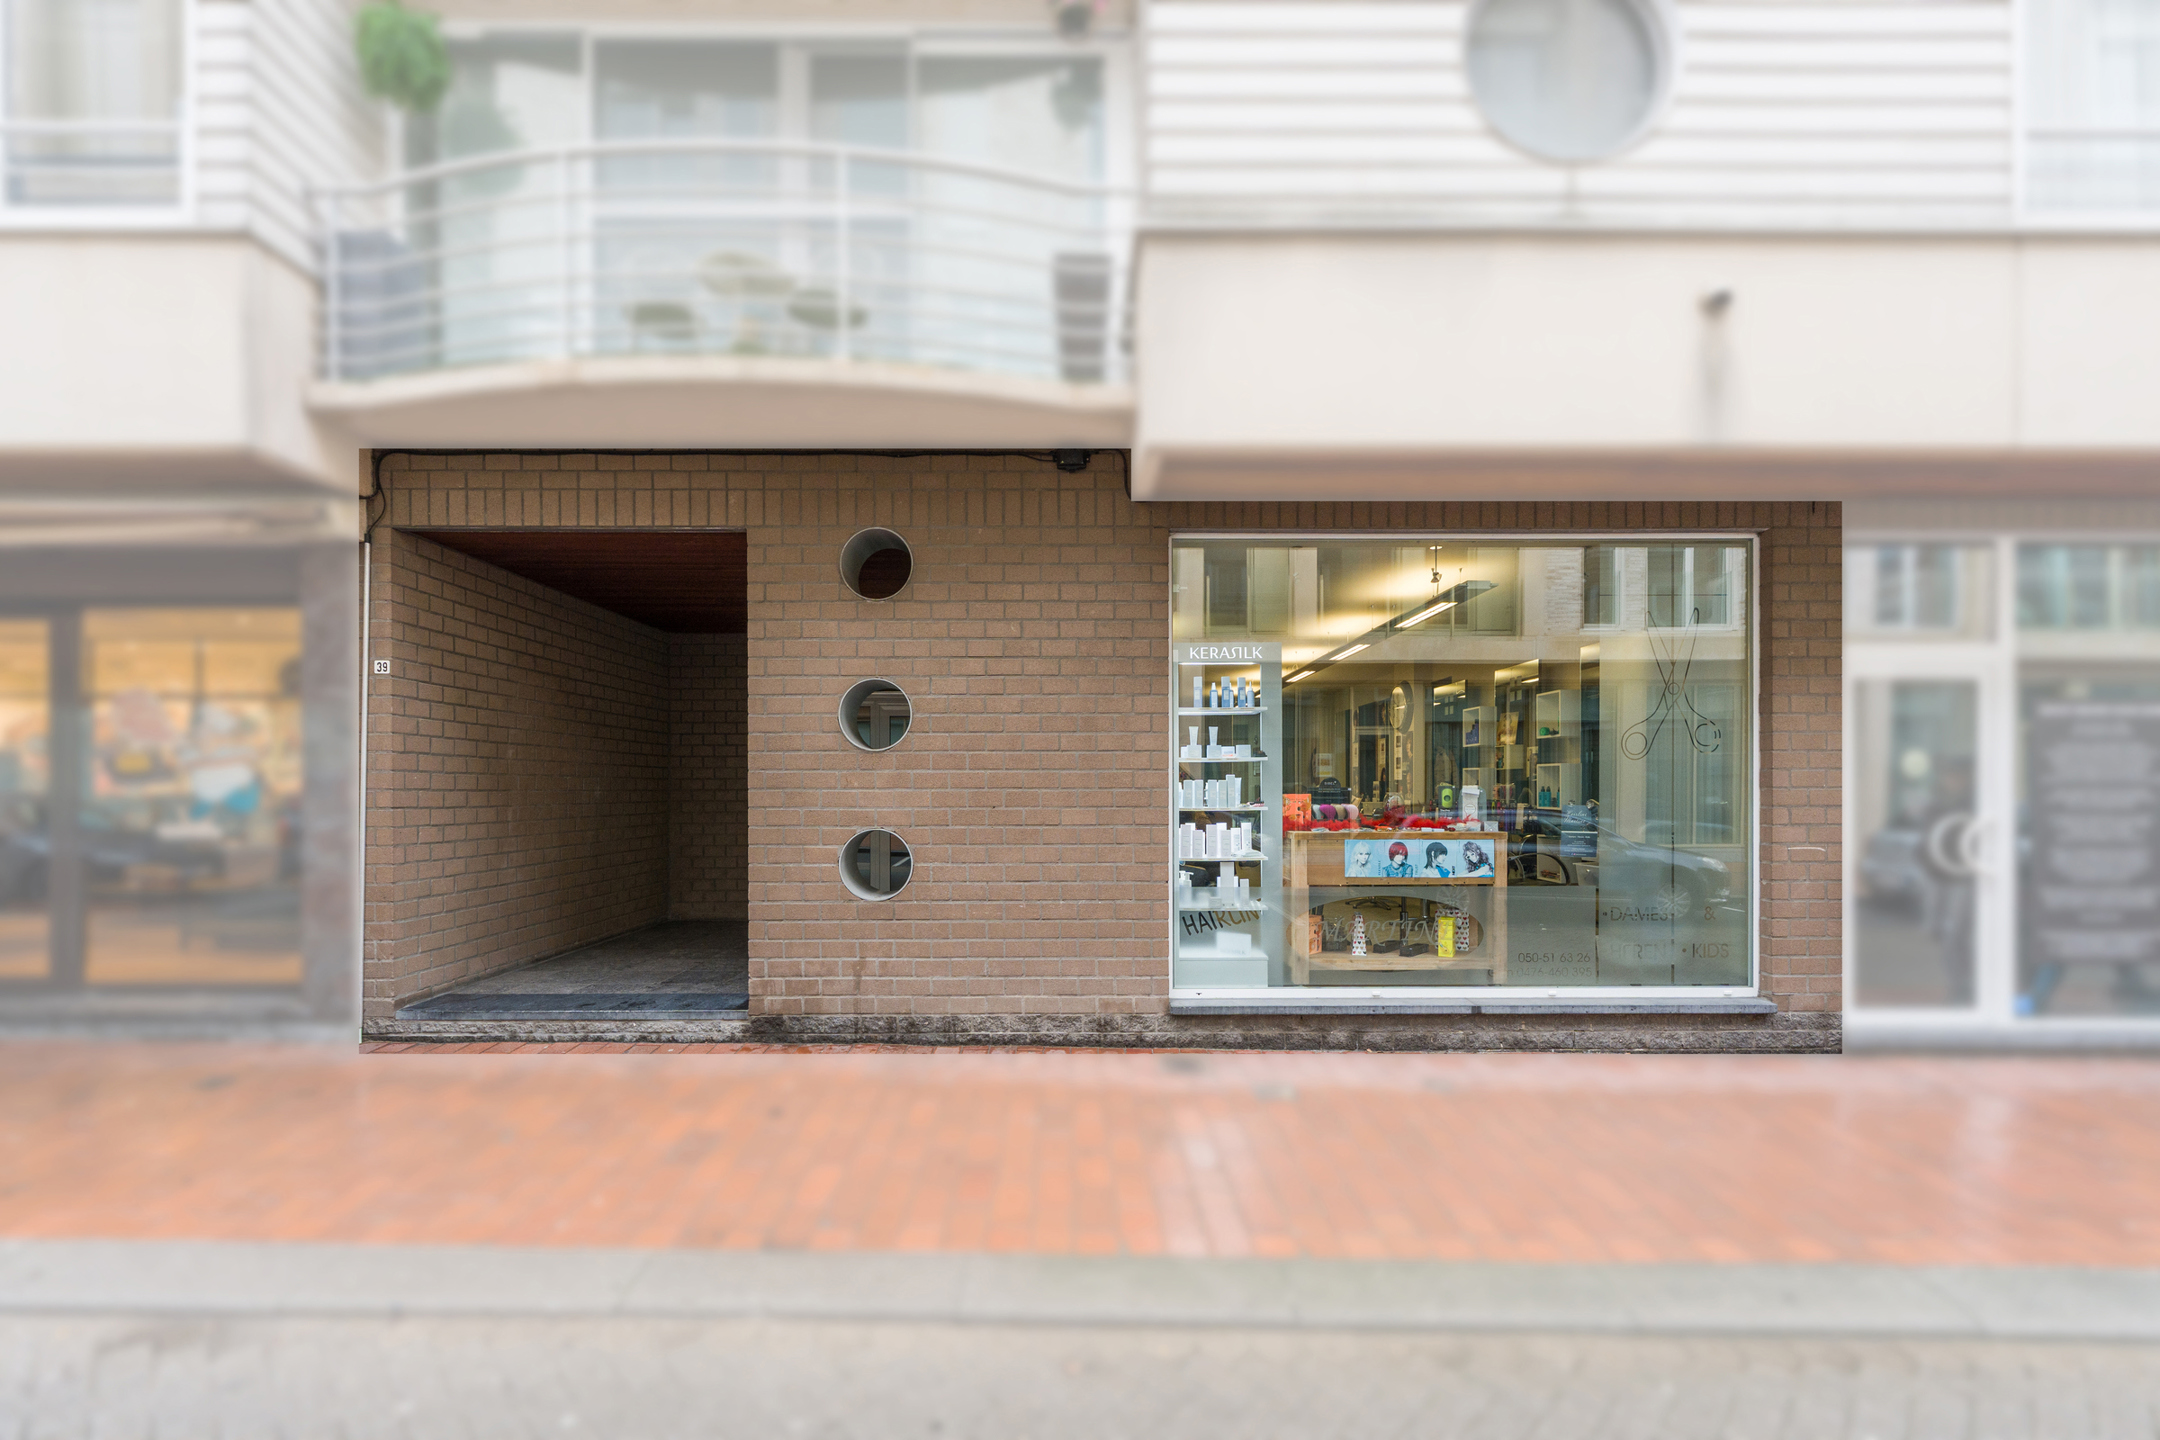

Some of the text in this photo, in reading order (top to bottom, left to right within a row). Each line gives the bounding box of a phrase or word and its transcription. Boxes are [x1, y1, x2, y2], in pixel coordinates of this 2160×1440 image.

[1189, 646, 1263, 659] KERASILK
[376, 661, 388, 672] 39
[1181, 903, 1262, 936] HAIRLIN
[1610, 905, 1716, 921] DAMES &
[1518, 952, 1555, 963] 050-51
[1560, 952, 1574, 963] 63
[1577, 952, 1591, 963] 26
[1692, 943, 1730, 959] KIDS
[1572, 967, 1592, 978] 395
